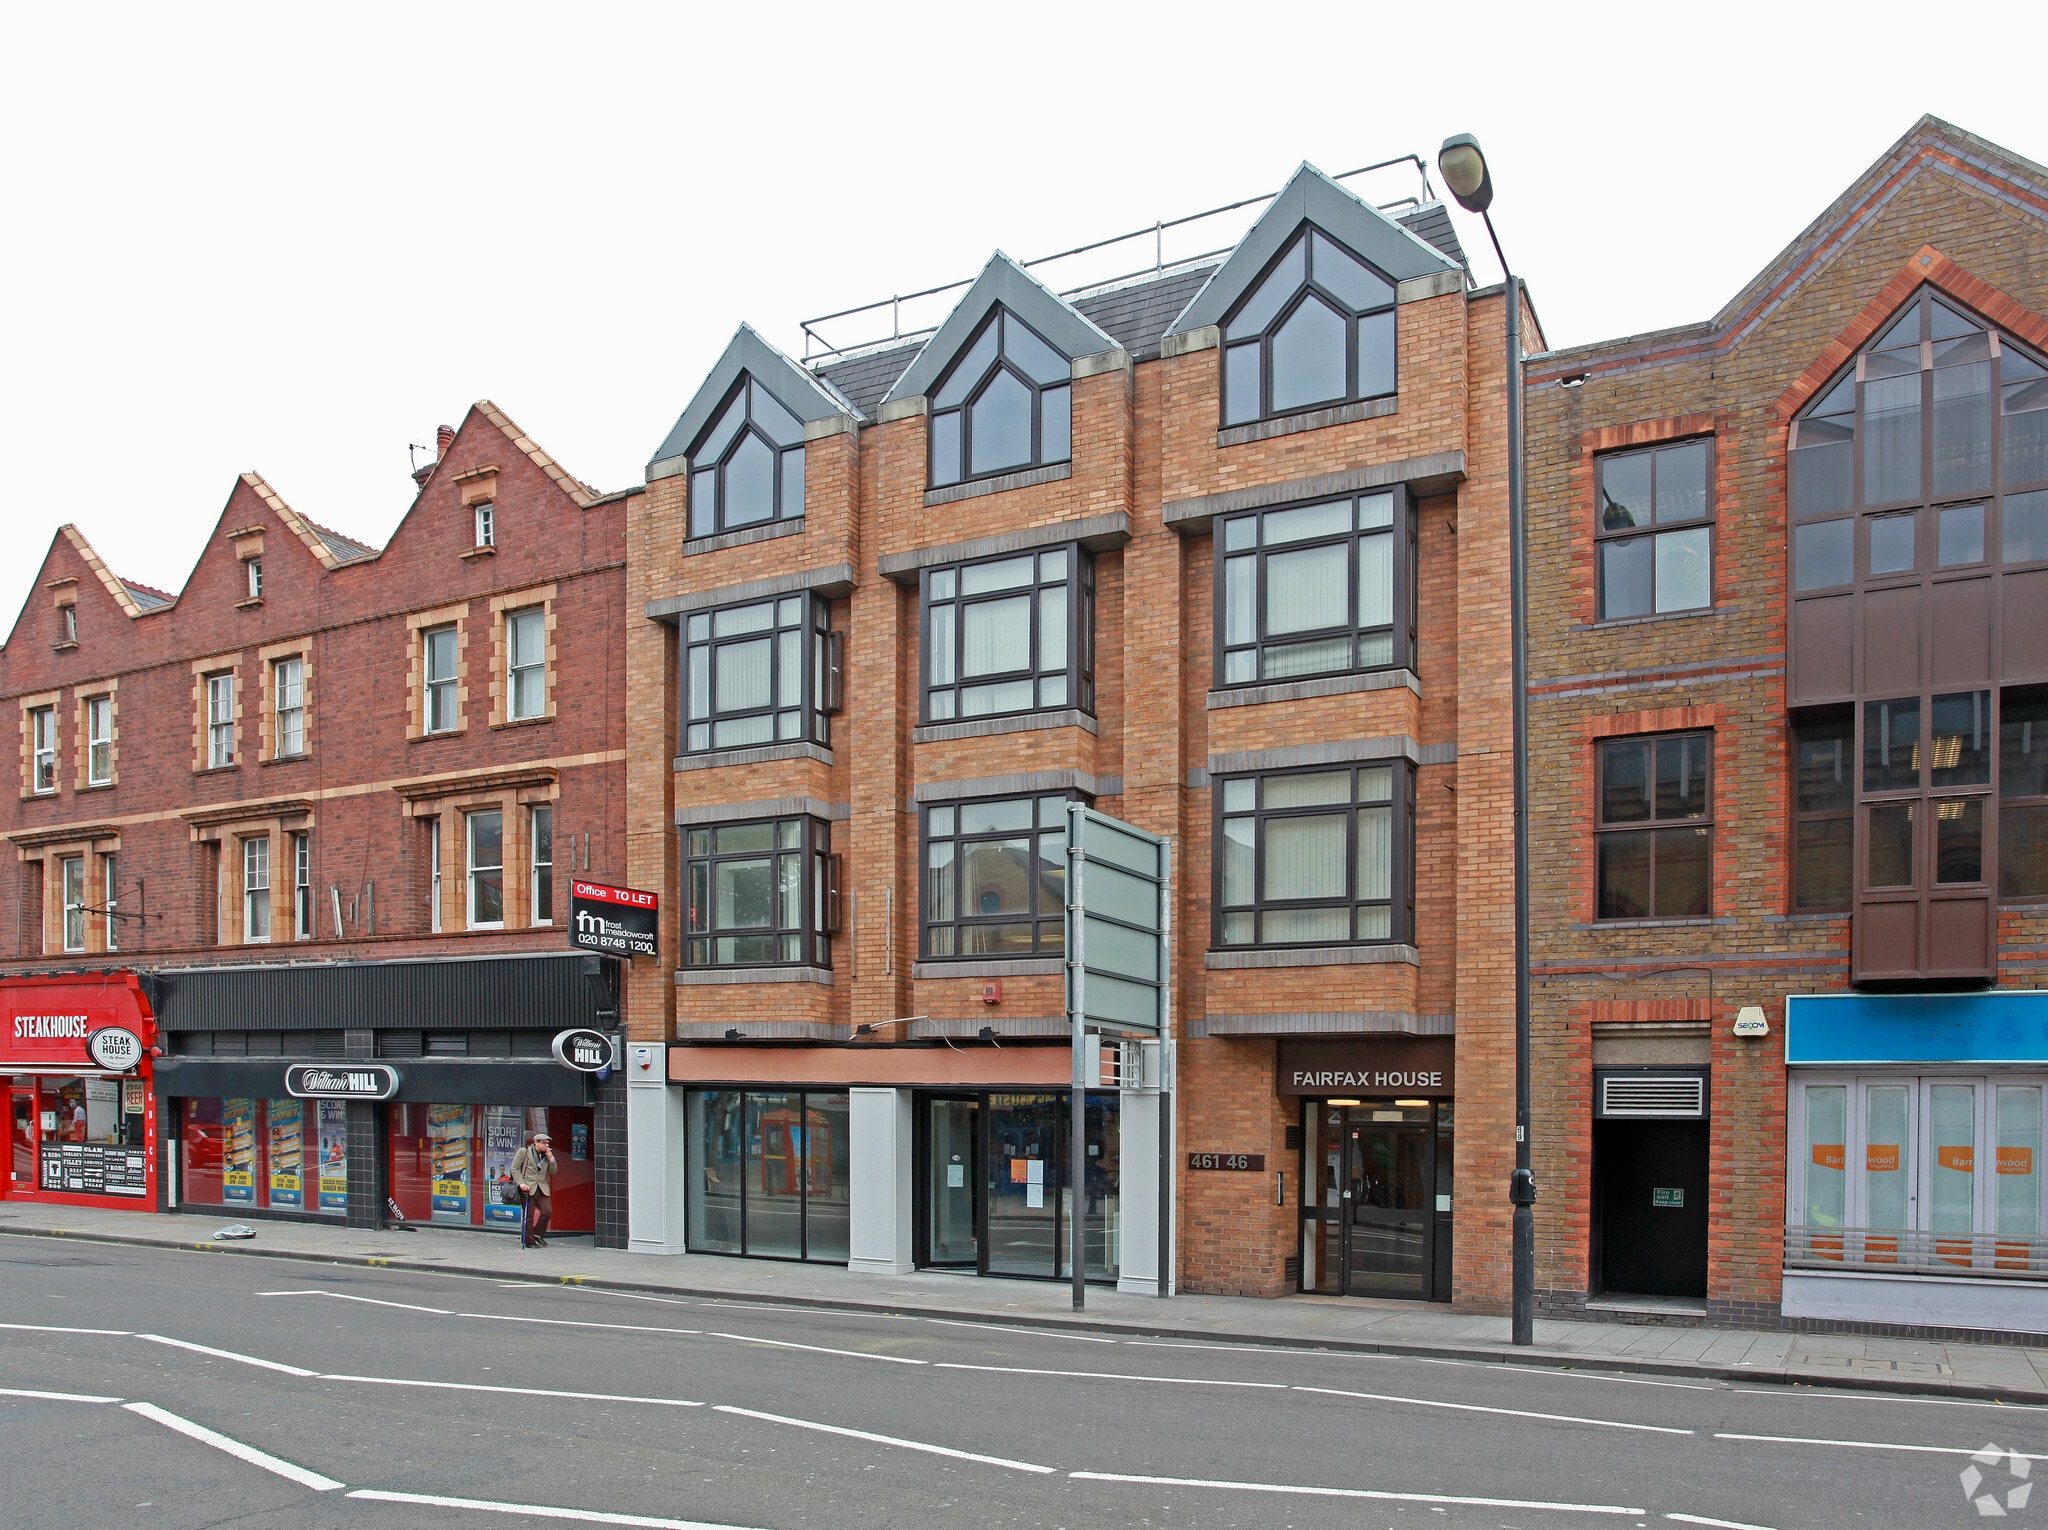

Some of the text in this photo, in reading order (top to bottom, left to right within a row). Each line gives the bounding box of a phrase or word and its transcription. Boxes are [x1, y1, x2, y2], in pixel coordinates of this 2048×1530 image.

[576, 884, 653, 905] Office TO LET
[576, 910, 606, 934] fm
[606, 920, 622, 930] frost
[606, 928, 654, 940] meadowcroft
[578, 934, 653, 952] 020 8748 1200
[14, 1016, 88, 1038] STEAKHOUSE
[1738, 1022, 1764, 1030] SECOM
[102, 1035, 131, 1046] STEAK
[572, 1036, 602, 1048] William
[102, 1045, 131, 1055] HOUSE
[574, 1048, 602, 1064] HILL
[302, 1069, 378, 1091] William HILL
[1294, 1071, 1442, 1087] FAIRFAX HOUSE
[126, 1091, 142, 1105] BEER
[320, 1100, 346, 1109] SCORE
[320, 1110, 326, 1119] &
[488, 1126, 517, 1137] SCORE
[488, 1137, 515, 1148] & WIN.
[1190, 1154, 1248, 1170] 461 46
[1868, 1156, 1895, 1164] wood
[392, 1201, 405, 1220] SLOTS
